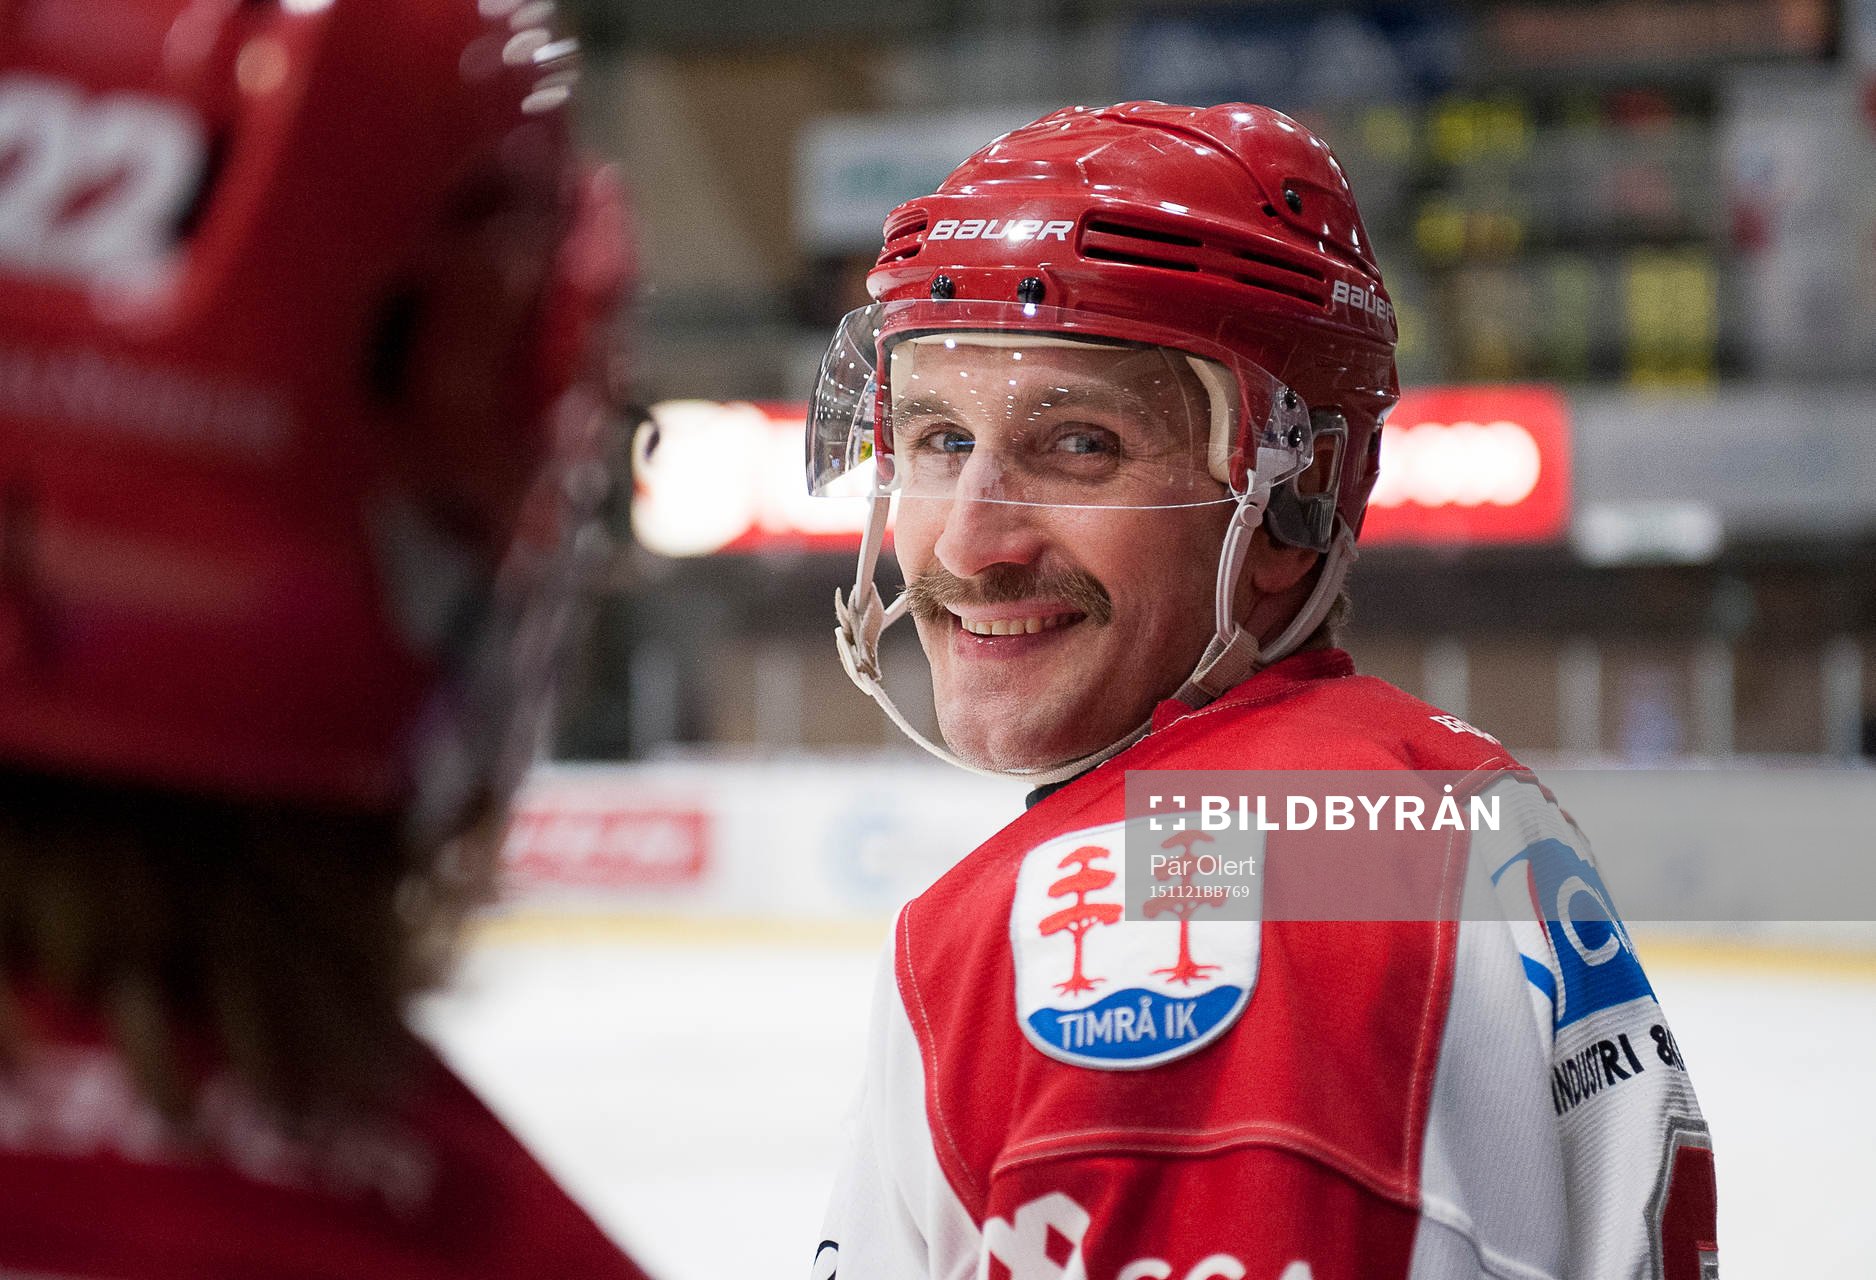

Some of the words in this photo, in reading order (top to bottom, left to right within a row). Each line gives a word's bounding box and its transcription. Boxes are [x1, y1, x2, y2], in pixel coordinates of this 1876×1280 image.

[927, 219, 1074, 241] BAUER
[1056, 996, 1158, 1050] TIMRÅ
[1164, 1001, 1199, 1040] IK
[1551, 1033, 1645, 1116] INDUSTRI
